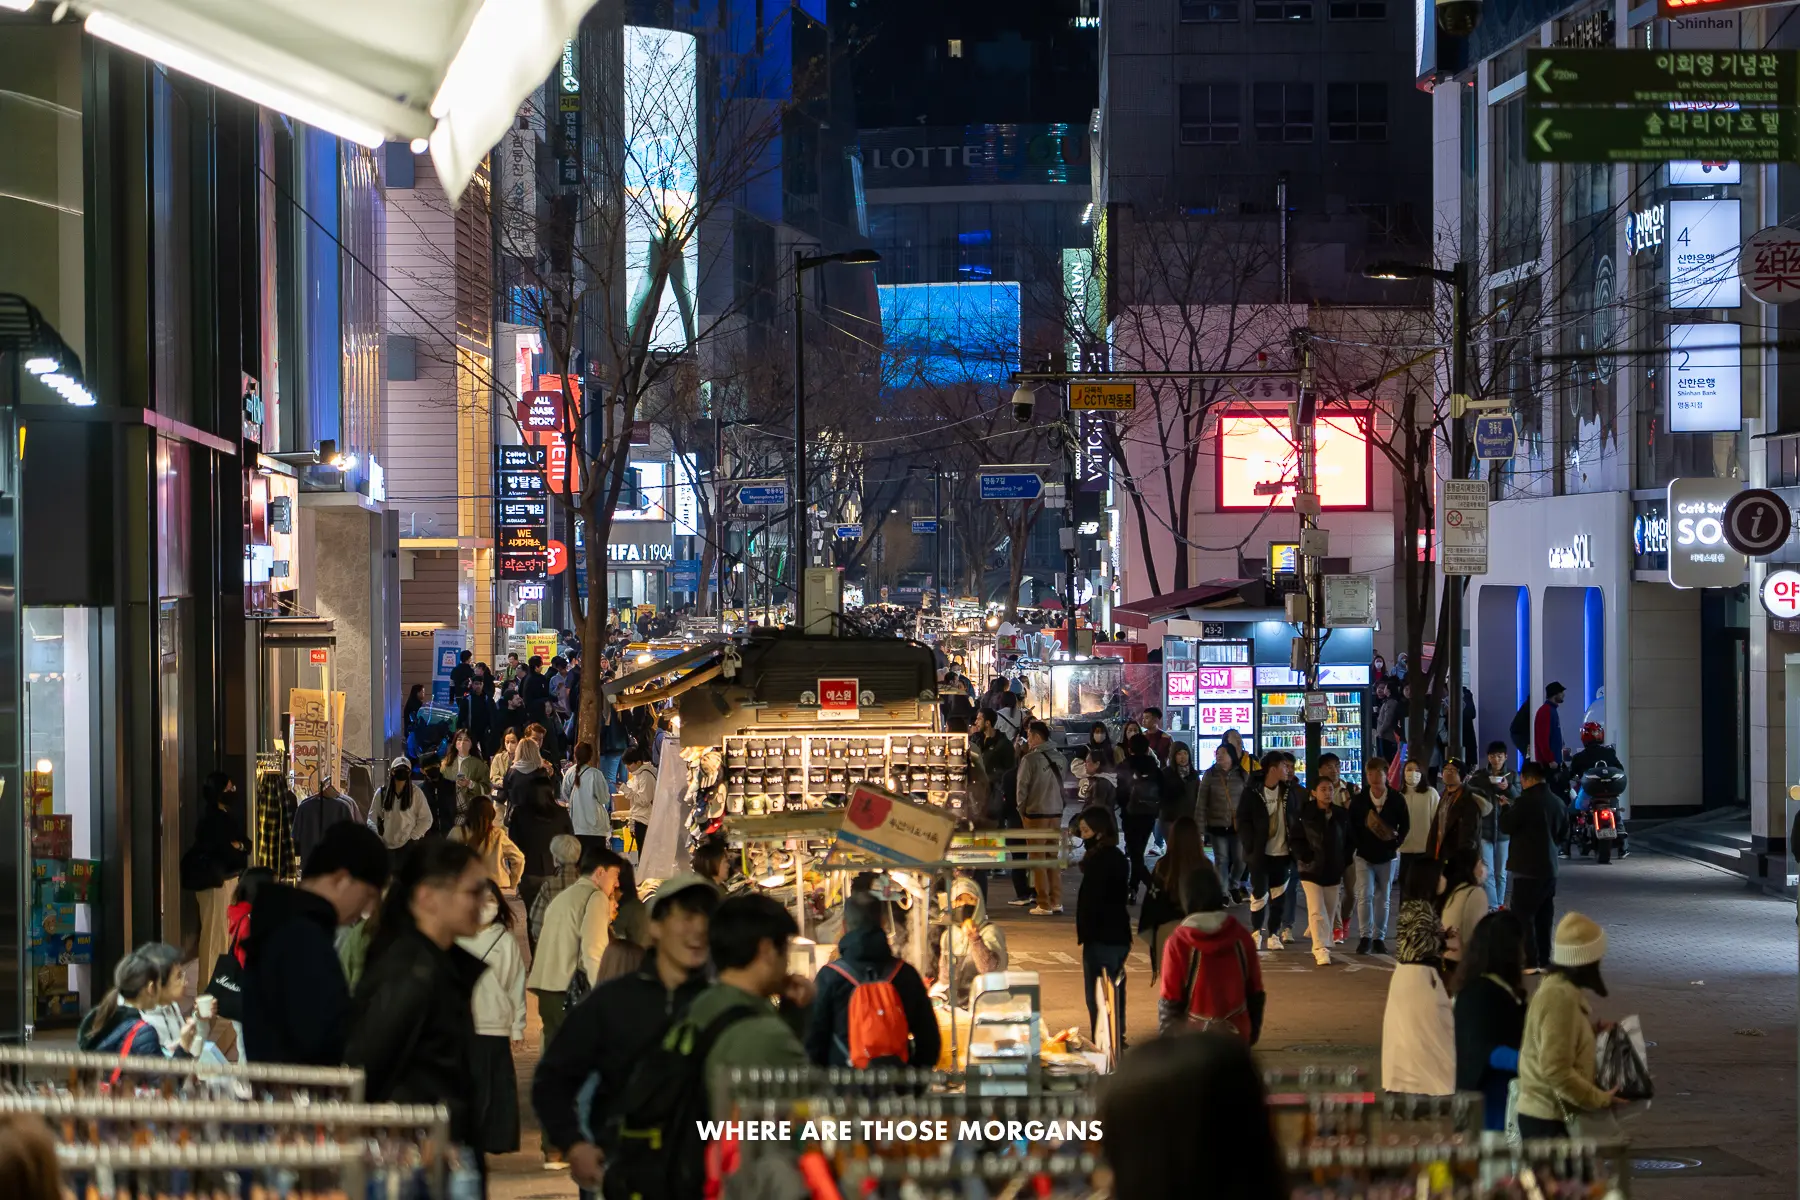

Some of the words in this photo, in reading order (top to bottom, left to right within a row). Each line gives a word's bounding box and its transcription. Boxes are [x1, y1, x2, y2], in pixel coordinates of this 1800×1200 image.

[1677, 17, 1733, 29] Shinhan
[1656, 53, 1714, 76] 이회영
[1720, 53, 1779, 76] 기념관
[873, 145, 984, 169] LOTTE
[1677, 227, 1691, 246] 4
[1677, 254, 1715, 264] 신한은행
[1677, 350, 1691, 371] 2
[1677, 378, 1716, 389] 신한은행
[533, 396, 551, 405] ALL
[1083, 393, 1132, 407] CCTV작동중
[1677, 401, 1703, 409] 명동지점
[528, 416, 556, 426] STORY
[507, 475, 541, 489] 방탈출
[983, 477, 1006, 485] 명동7길
[505, 504, 545, 515] 보드게임
[1677, 502, 1706, 514] Café
[517, 529, 532, 538] WE
[1644, 518, 1668, 553] 신한은
[1677, 517, 1728, 545] SO
[508, 539, 541, 547] 시계거래소
[649, 544, 673, 561] 1904
[505, 559, 546, 571] 약손명가
[1773, 581, 1800, 610] 약
[1204, 626, 1223, 635] 43-2
[826, 690, 852, 701] 에스원
[1202, 707, 1250, 723] 상품권
